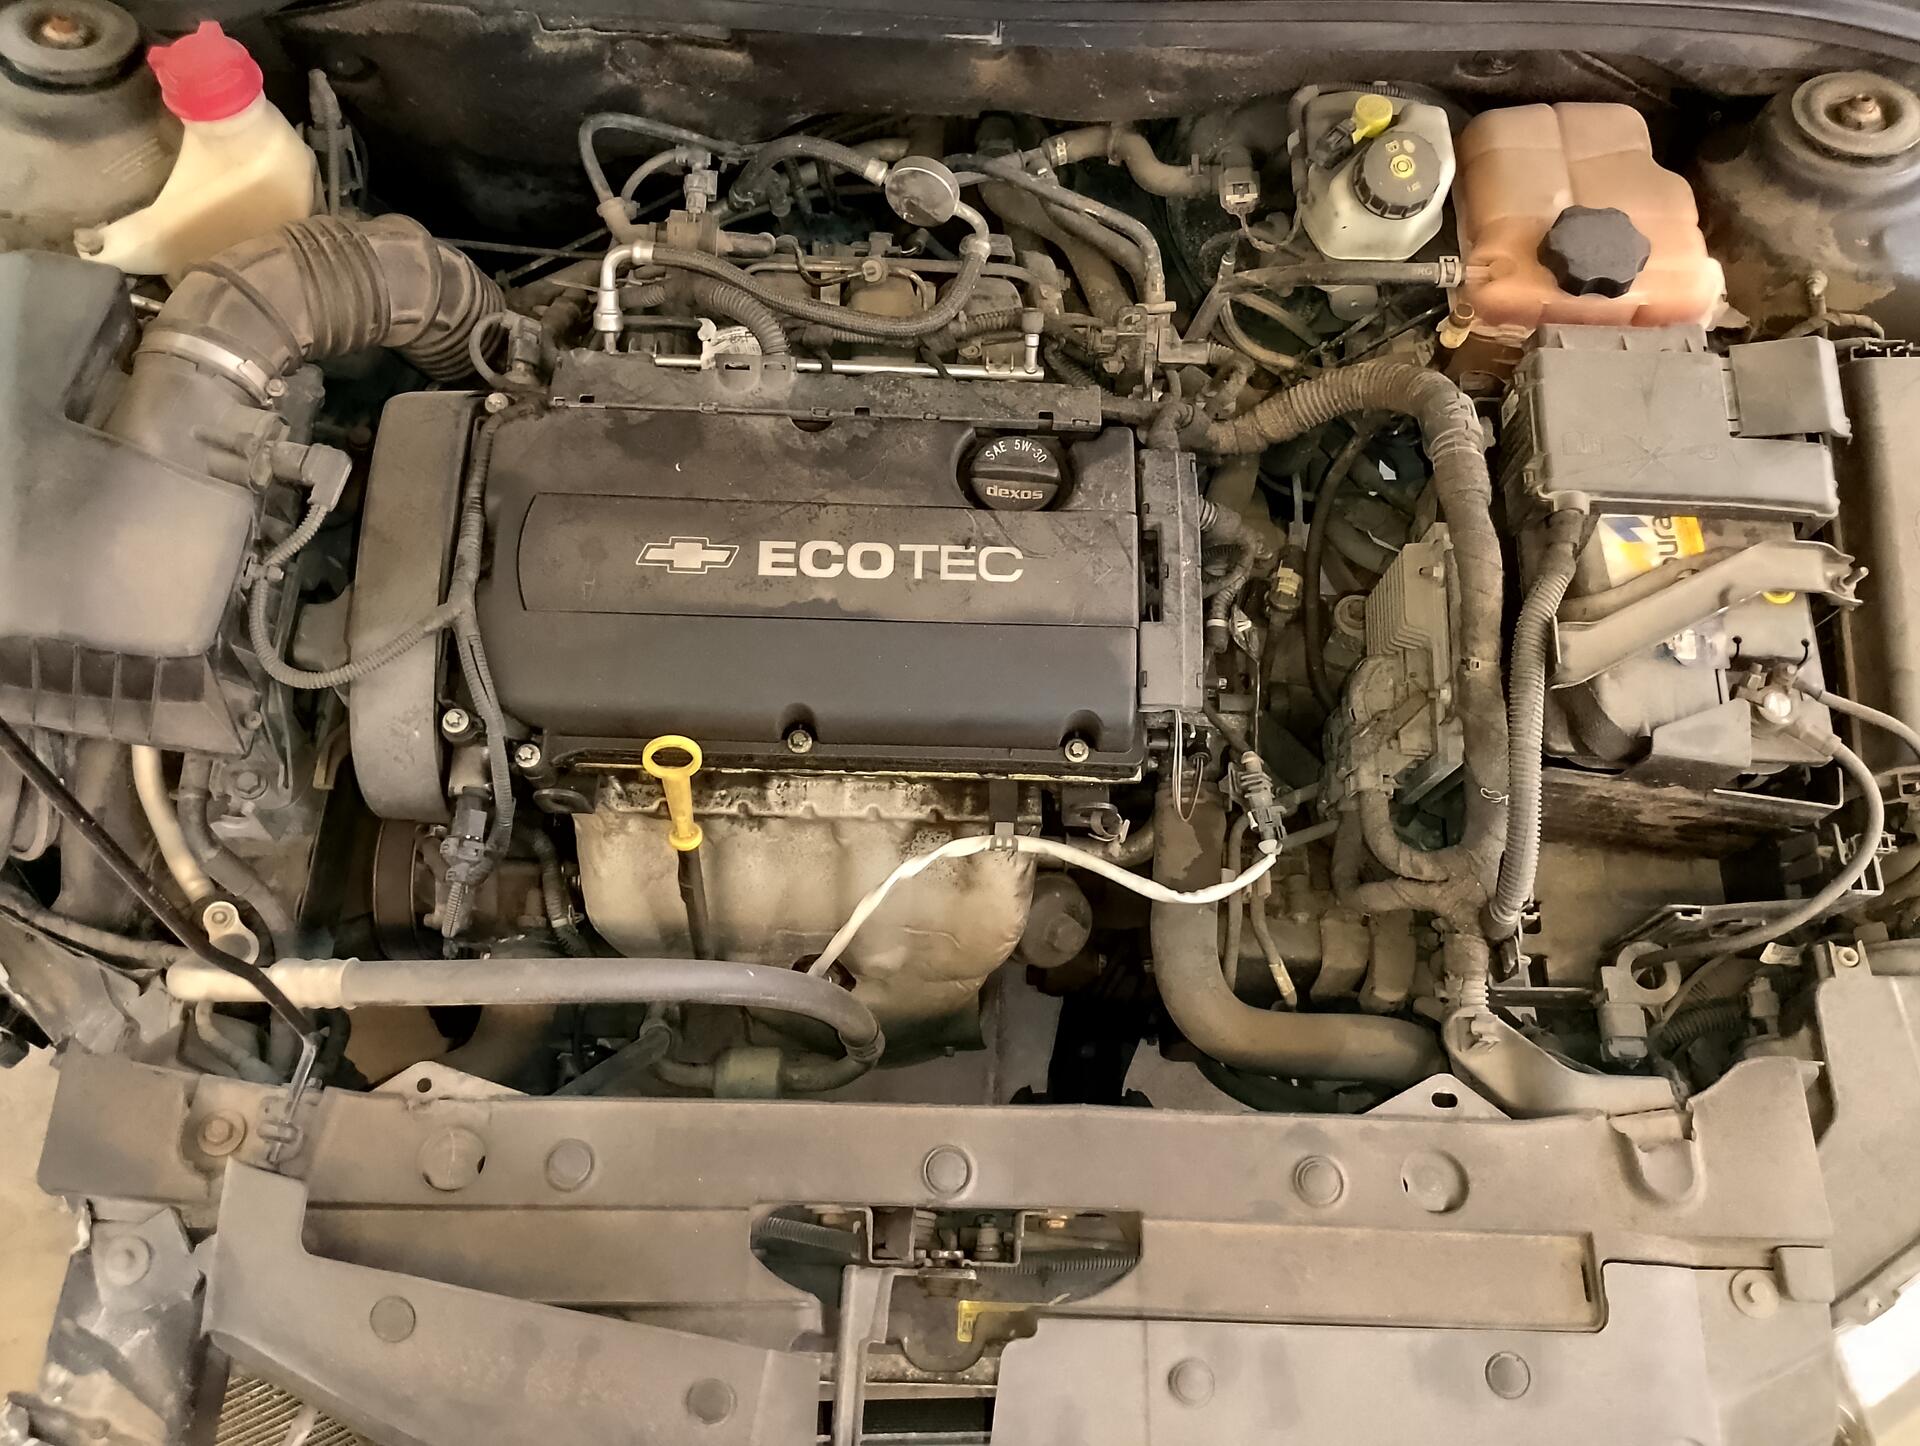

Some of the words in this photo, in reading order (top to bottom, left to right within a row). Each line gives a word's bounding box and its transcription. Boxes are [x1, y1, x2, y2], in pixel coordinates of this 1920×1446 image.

[985, 441, 1007, 460] SAE
[1014, 439, 1047, 463] 5W-30
[986, 485, 1043, 500] dexos
[758, 540, 1024, 582] ECOTEC
